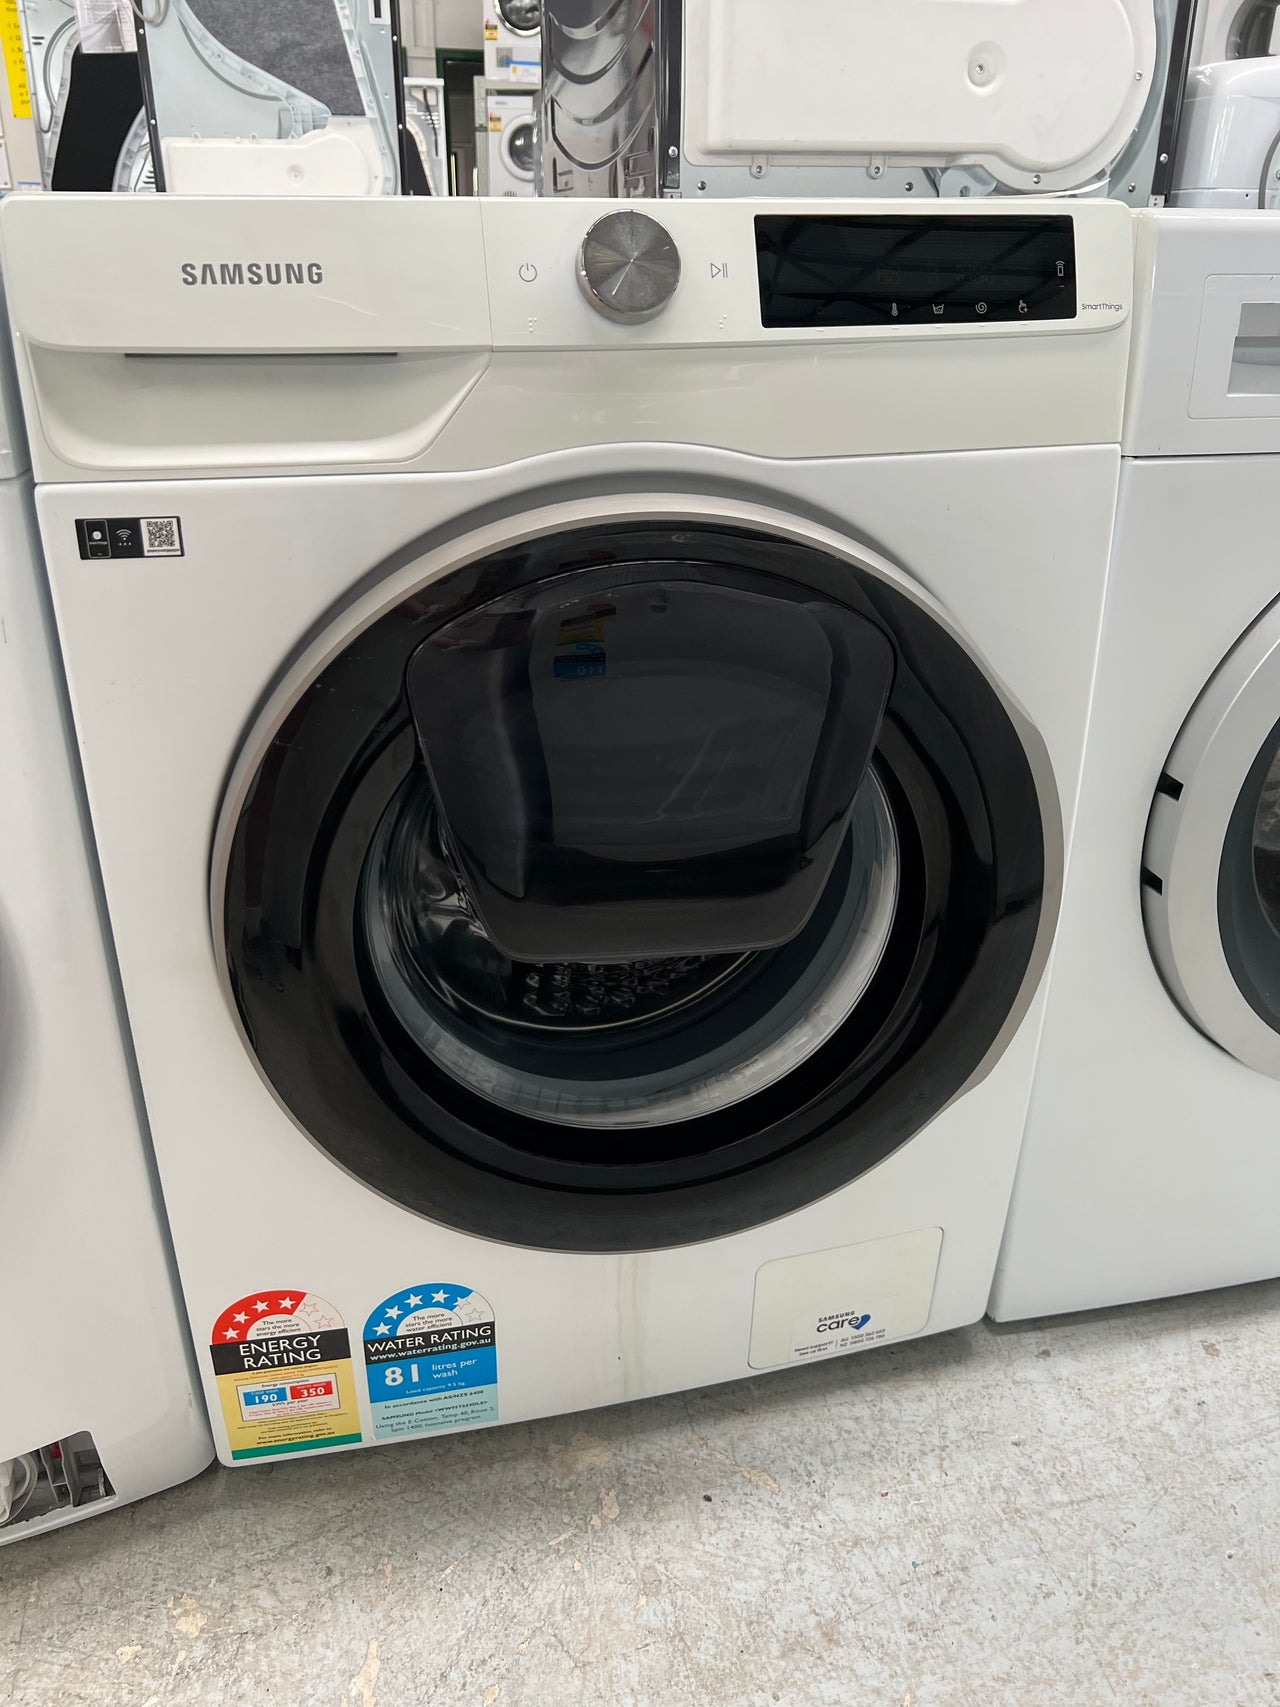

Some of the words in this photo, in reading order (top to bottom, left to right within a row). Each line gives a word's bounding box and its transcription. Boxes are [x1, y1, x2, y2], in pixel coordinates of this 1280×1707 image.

[182, 262, 323, 286] SAMSUNG
[1082, 303, 1123, 312] SmartThings
[818, 1310, 855, 1322] SAMSUNG
[816, 1316, 860, 1332] care
[368, 1336, 425, 1352] WATER
[431, 1326, 491, 1344] RATING
[239, 1335, 321, 1356] ENERGY
[370, 1338, 491, 1361] www.waterrating.gov.au
[244, 1349, 322, 1369] RATING
[432, 1363, 457, 1371] litres
[460, 1359, 478, 1368] per
[384, 1364, 419, 1386] 81
[432, 1369, 458, 1379] wash
[301, 1387, 325, 1398] 350
[255, 1394, 278, 1404] 190
[392, 1400, 428, 1408] accordance
[454, 1415, 481, 1424] program
